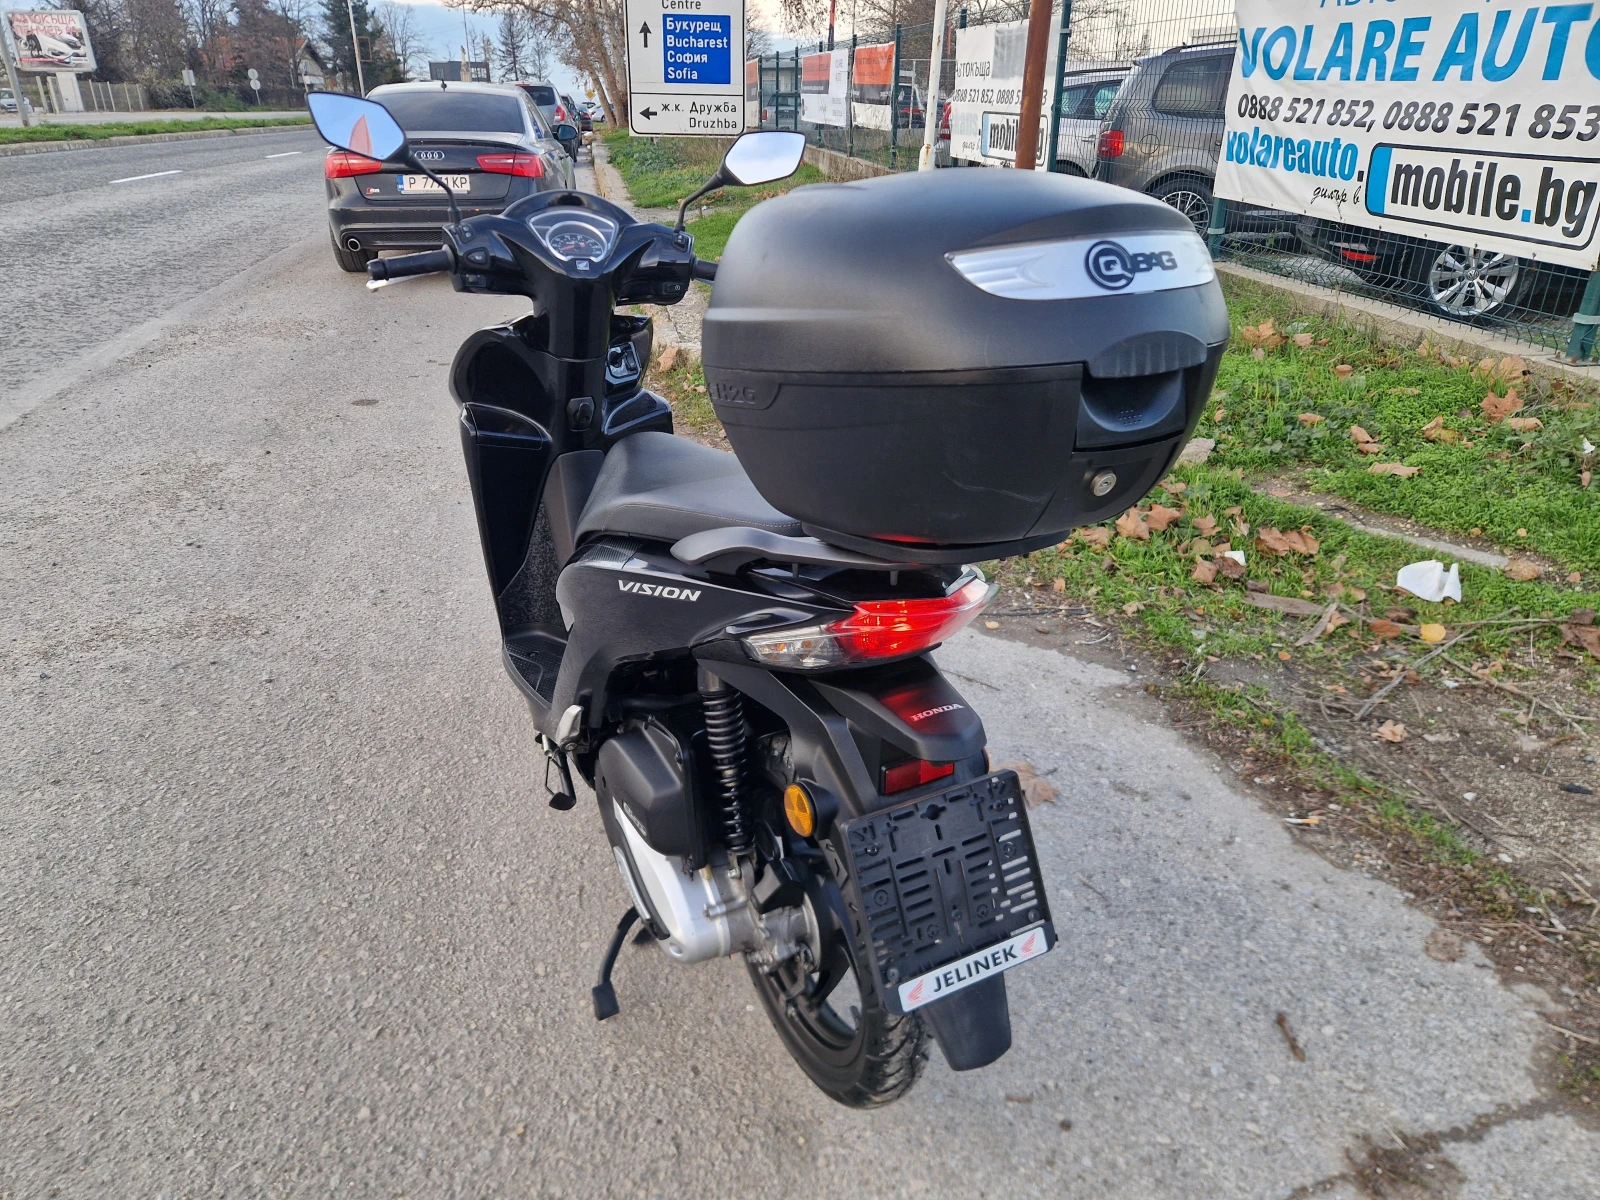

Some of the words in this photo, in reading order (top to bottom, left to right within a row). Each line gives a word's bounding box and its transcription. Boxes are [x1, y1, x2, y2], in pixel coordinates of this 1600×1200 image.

[662, 0, 702, 9] Centre
[666, 17, 721, 33] Букурещ
[666, 35, 728, 48] Bucharest
[1239, 16, 1432, 82] VOLARE
[667, 50, 708, 64] София
[667, 66, 698, 80] Sofia
[967, 89, 980, 103] 521
[996, 90, 1015, 105] 0888
[661, 103, 684, 112] ж.к.
[689, 101, 737, 115] Дружба
[689, 117, 737, 129] Druzhba
[1238, 93, 1284, 122] 0888
[1283, 97, 1326, 124] 521
[1326, 99, 1376, 133] 852,
[1382, 100, 1454, 133] 0888
[1456, 102, 1521, 137] 521
[1528, 104, 1600, 142] 853
[989, 118, 1045, 161] mobilg
[1390, 158, 1598, 239] mobile.bg
[618, 579, 702, 602] VISION
[910, 703, 965, 722] HONDA
[933, 944, 1018, 993] JELINEK
